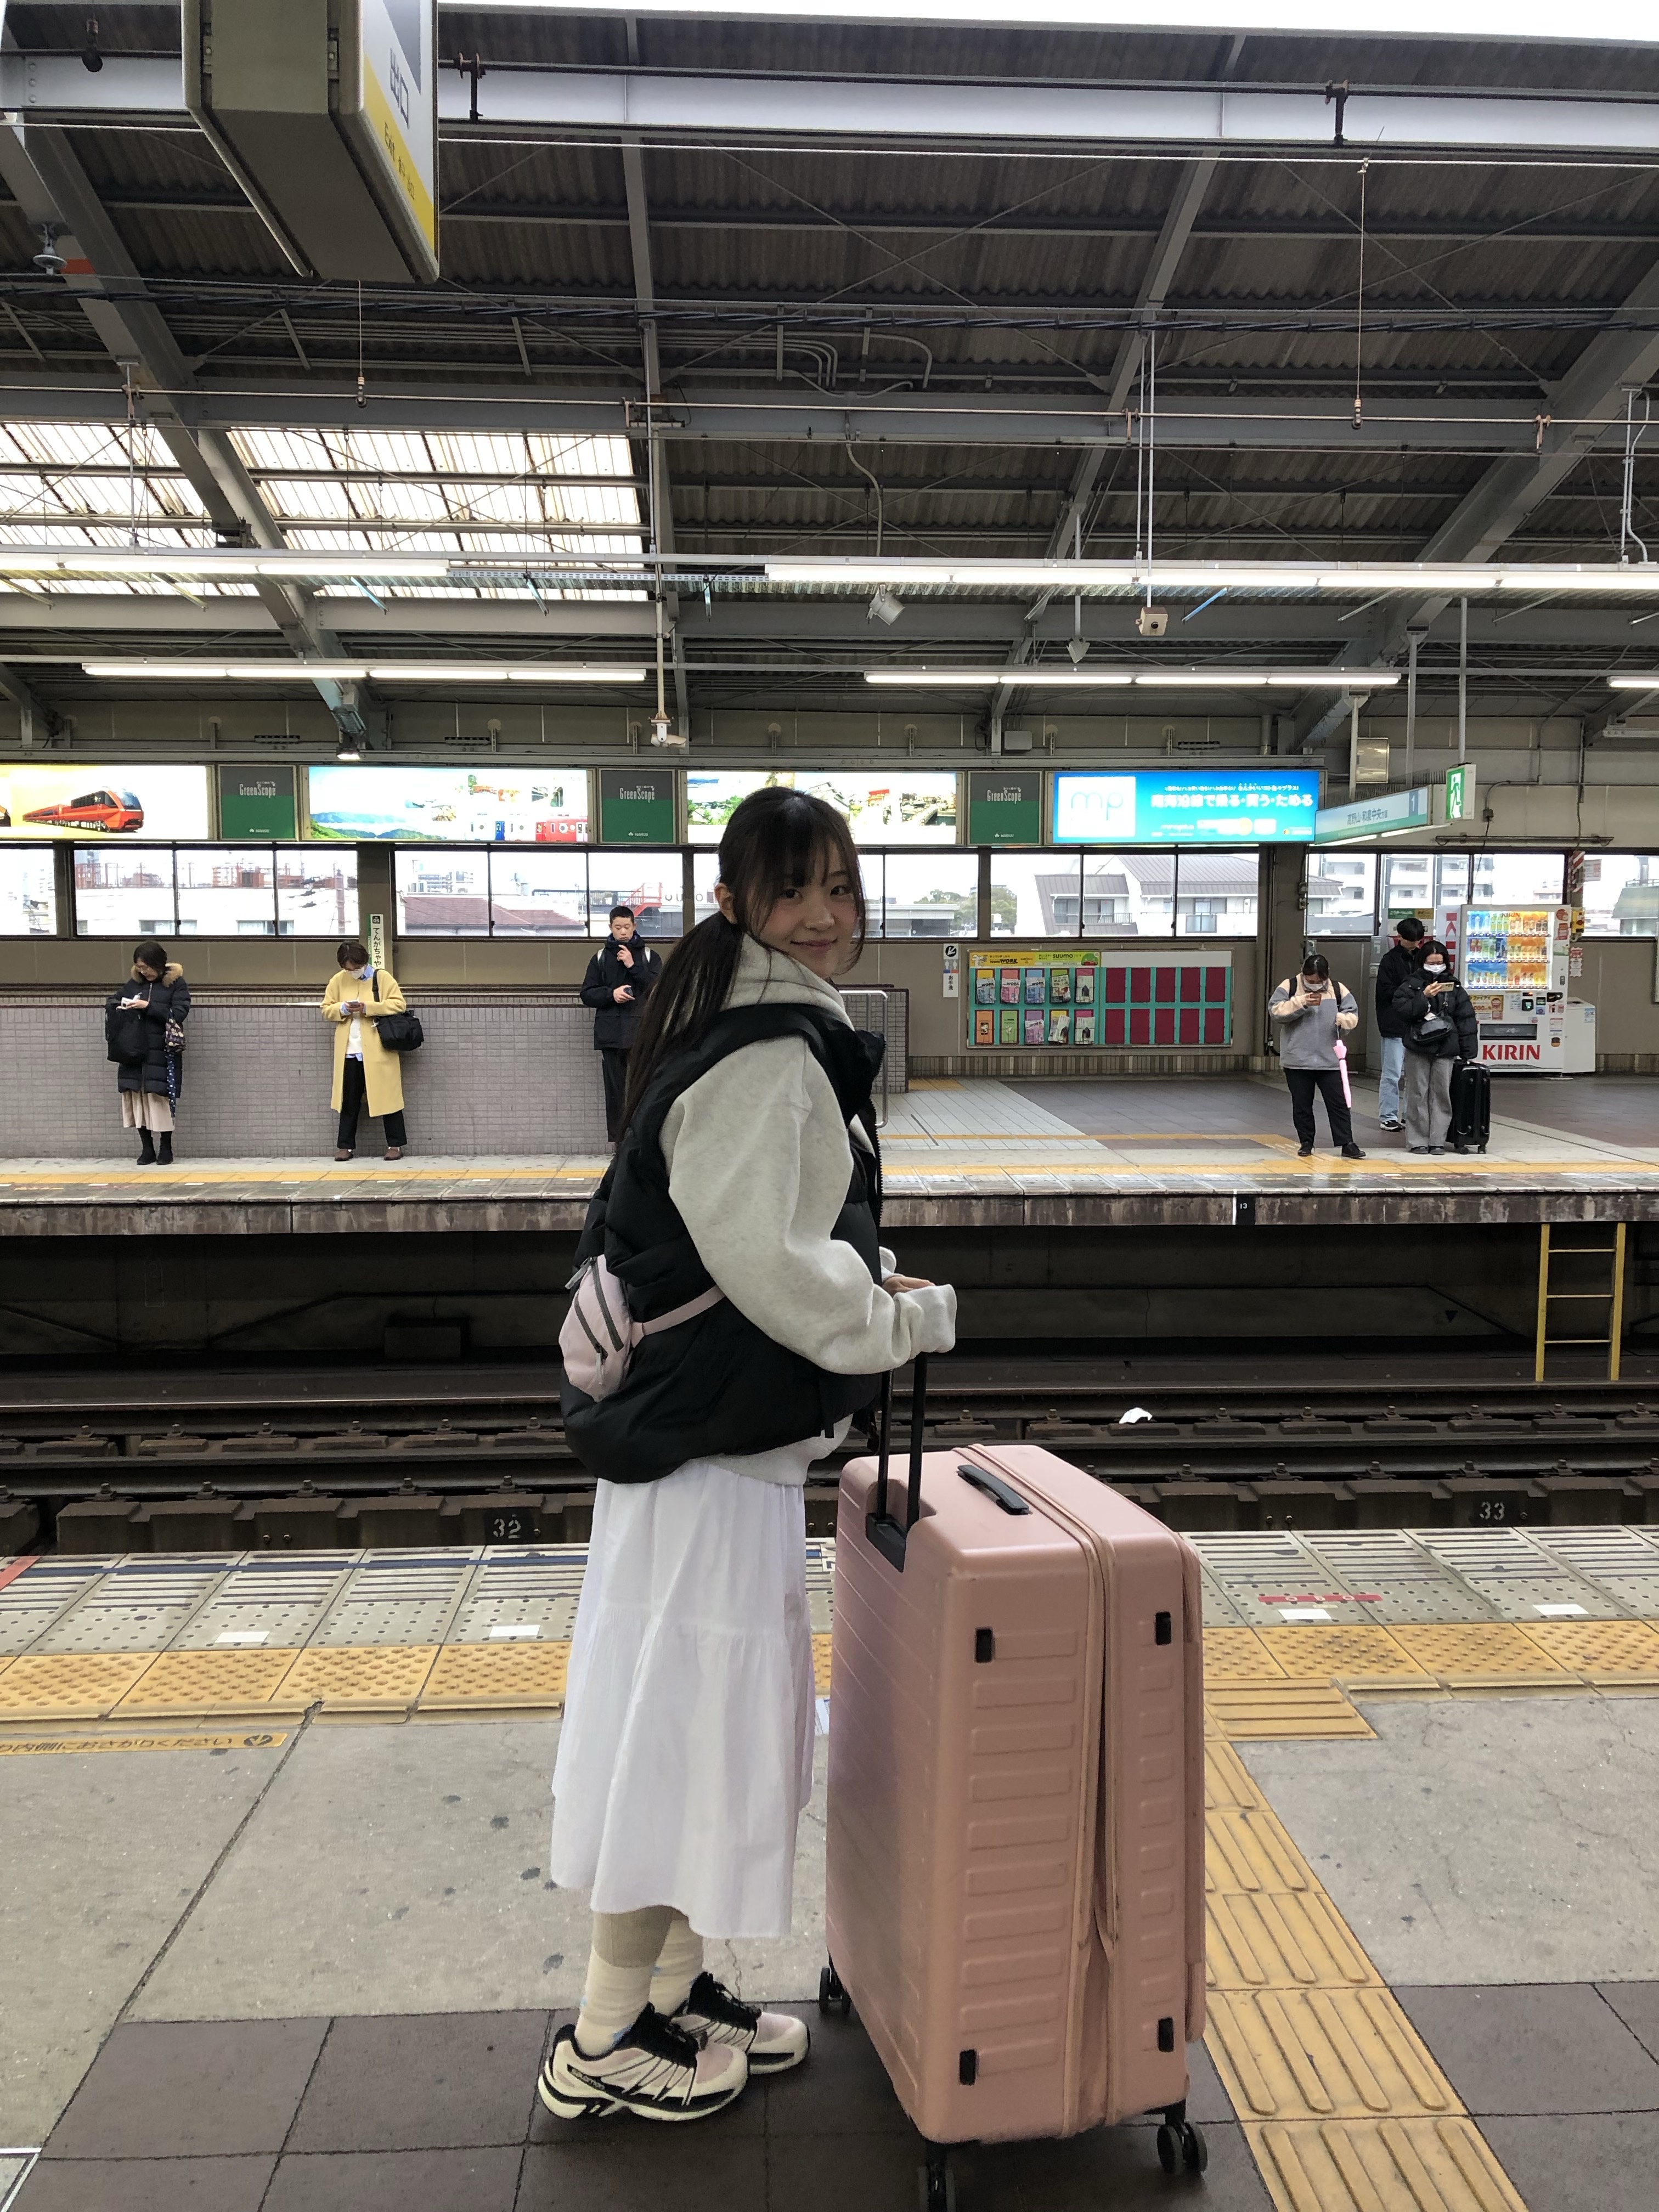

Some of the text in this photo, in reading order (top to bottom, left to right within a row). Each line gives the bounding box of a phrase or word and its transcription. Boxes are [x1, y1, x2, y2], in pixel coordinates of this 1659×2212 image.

[390, 48, 409, 129] 出口
[385, 121, 395, 162] Exit
[239, 783, 276, 798] GreenScope
[619, 787, 655, 803] GreenScope
[987, 789, 1022, 804] GreenScope
[1070, 792, 1124, 821] mp
[1411, 795, 1416, 812] 1
[373, 927, 382, 967] てんがちゃや
[1482, 1045, 1541, 1060] KIRIN
[1479, 1502, 1505, 1520] 33
[493, 1519, 521, 1539] 32
